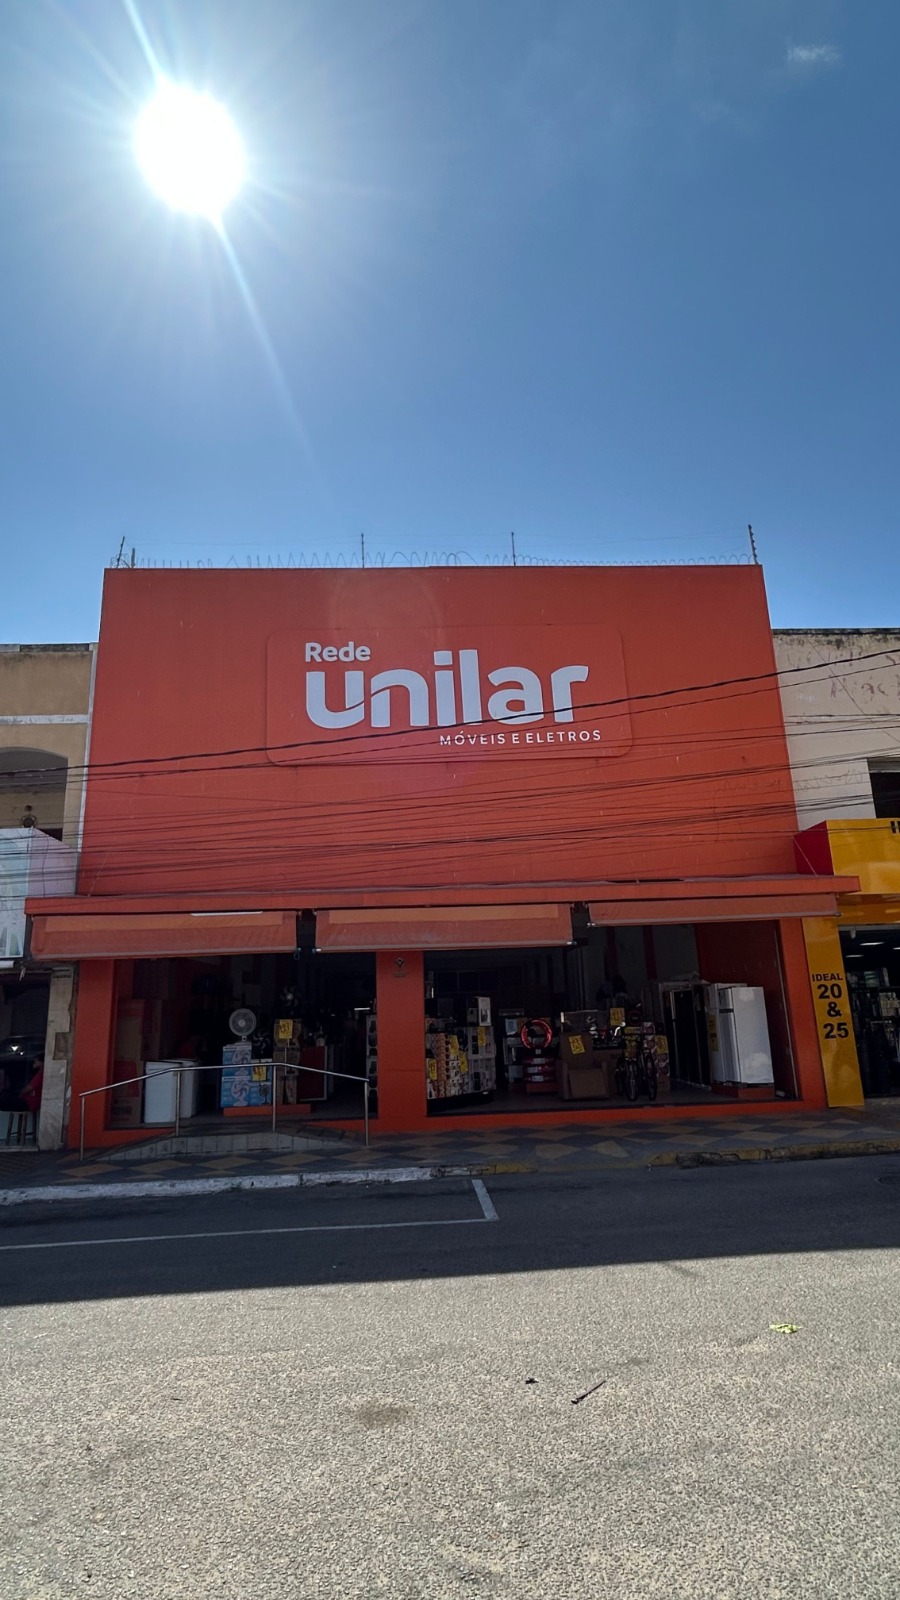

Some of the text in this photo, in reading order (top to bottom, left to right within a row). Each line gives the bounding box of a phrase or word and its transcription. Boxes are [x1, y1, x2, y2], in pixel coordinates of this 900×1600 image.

[305, 642, 371, 662] Rede
[306, 649, 589, 729] unilar
[439, 730, 602, 746] MÓVEIS E ELETROS
[812, 973, 844, 982] IDEAL
[817, 984, 842, 999] 20
[827, 1002, 842, 1018] &
[823, 1023, 849, 1039] 25
